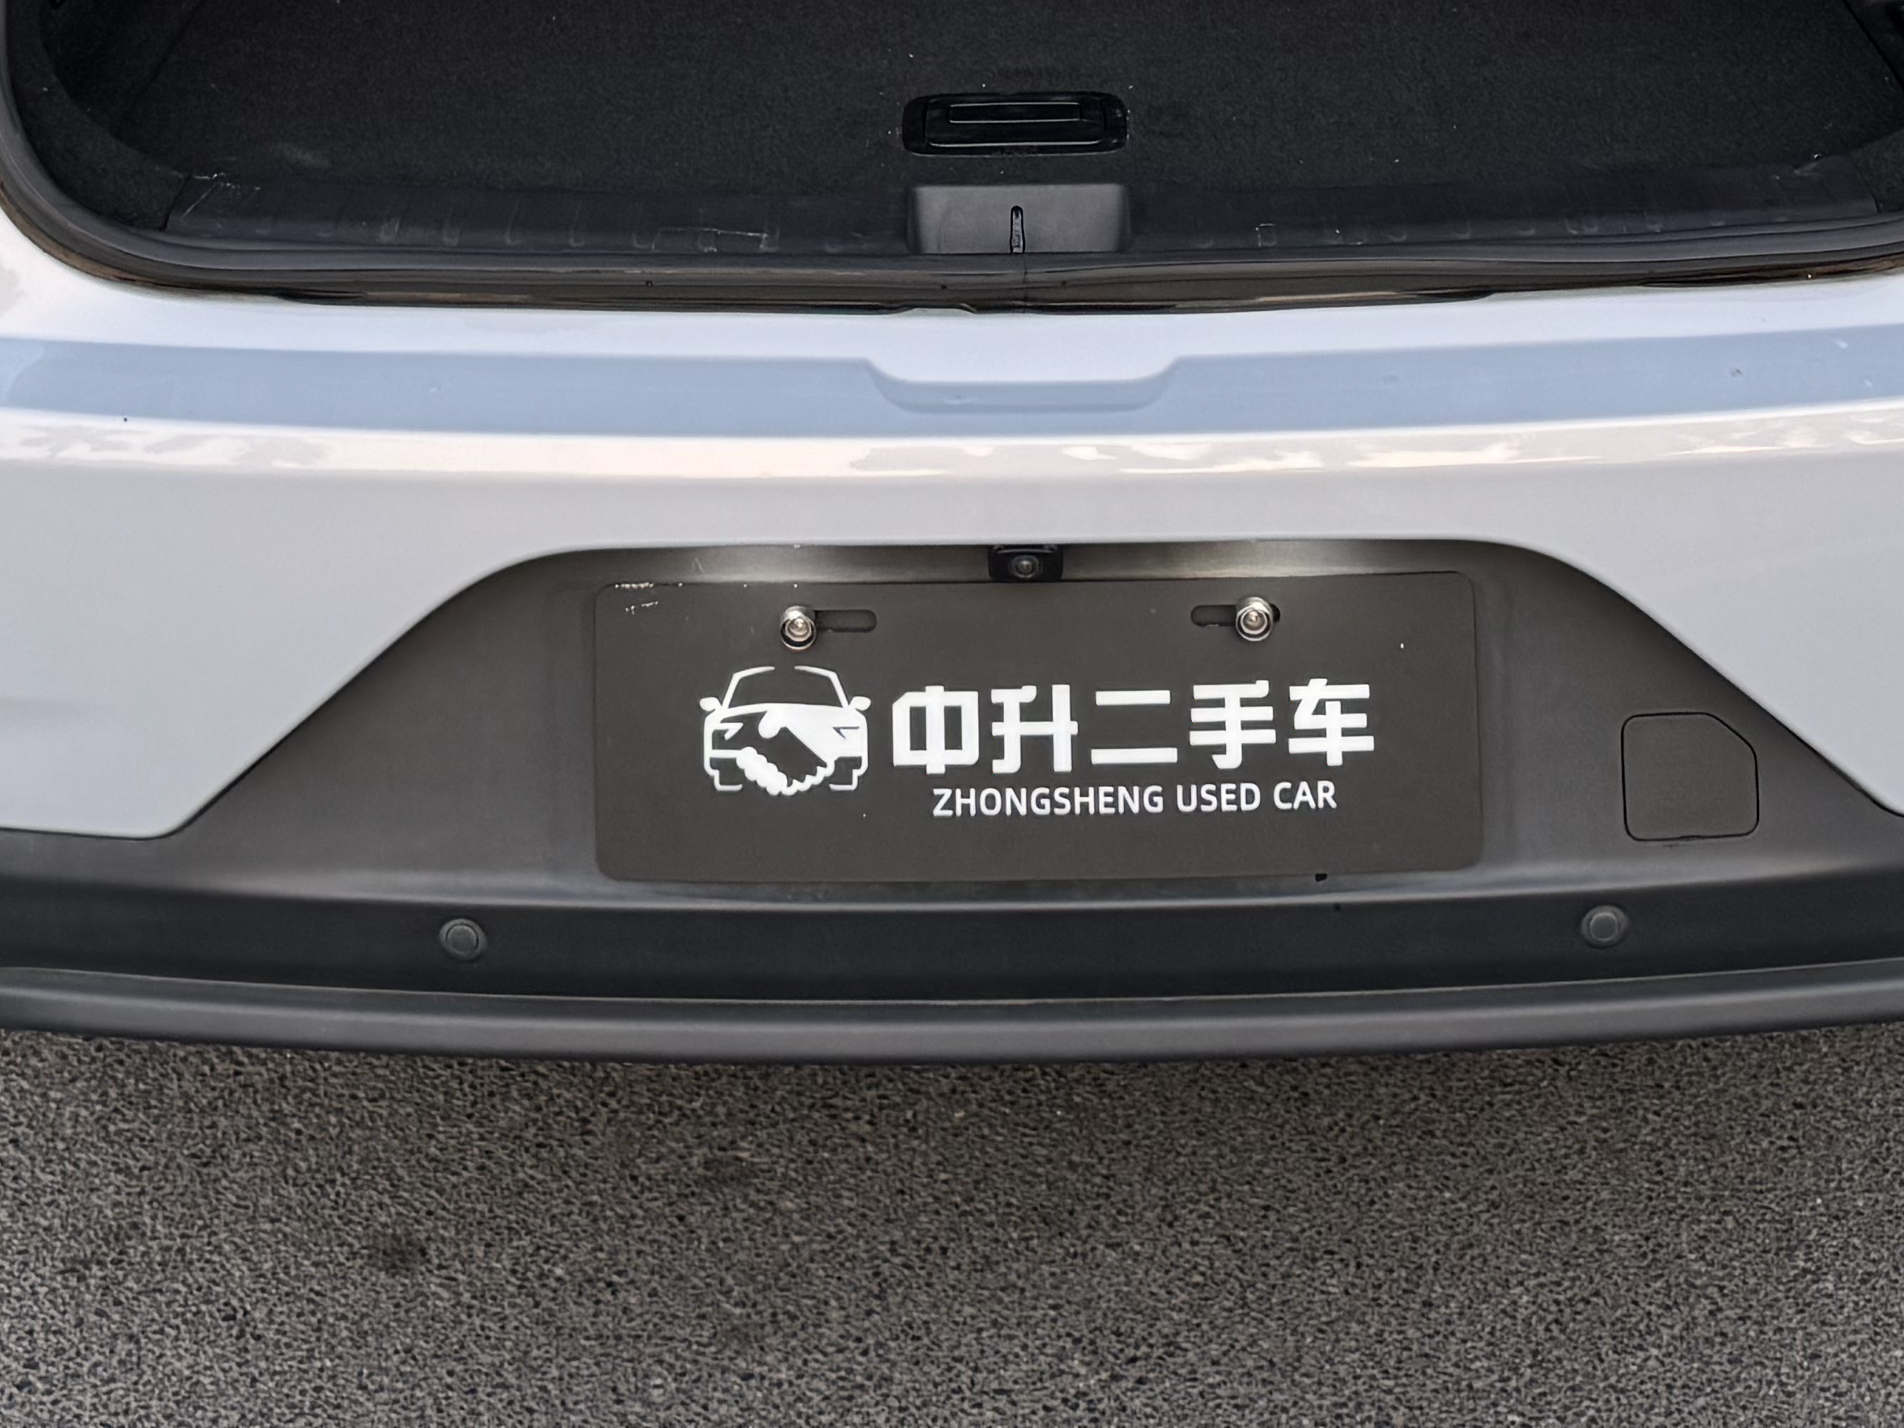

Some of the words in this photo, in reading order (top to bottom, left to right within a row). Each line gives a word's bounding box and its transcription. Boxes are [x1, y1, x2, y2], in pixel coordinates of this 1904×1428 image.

[893, 678, 1375, 775] 中升二手车
[933, 785, 1164, 819] ZHONGSHENG
[1176, 783, 1260, 813] USED
[1273, 780, 1337, 811] CAR
